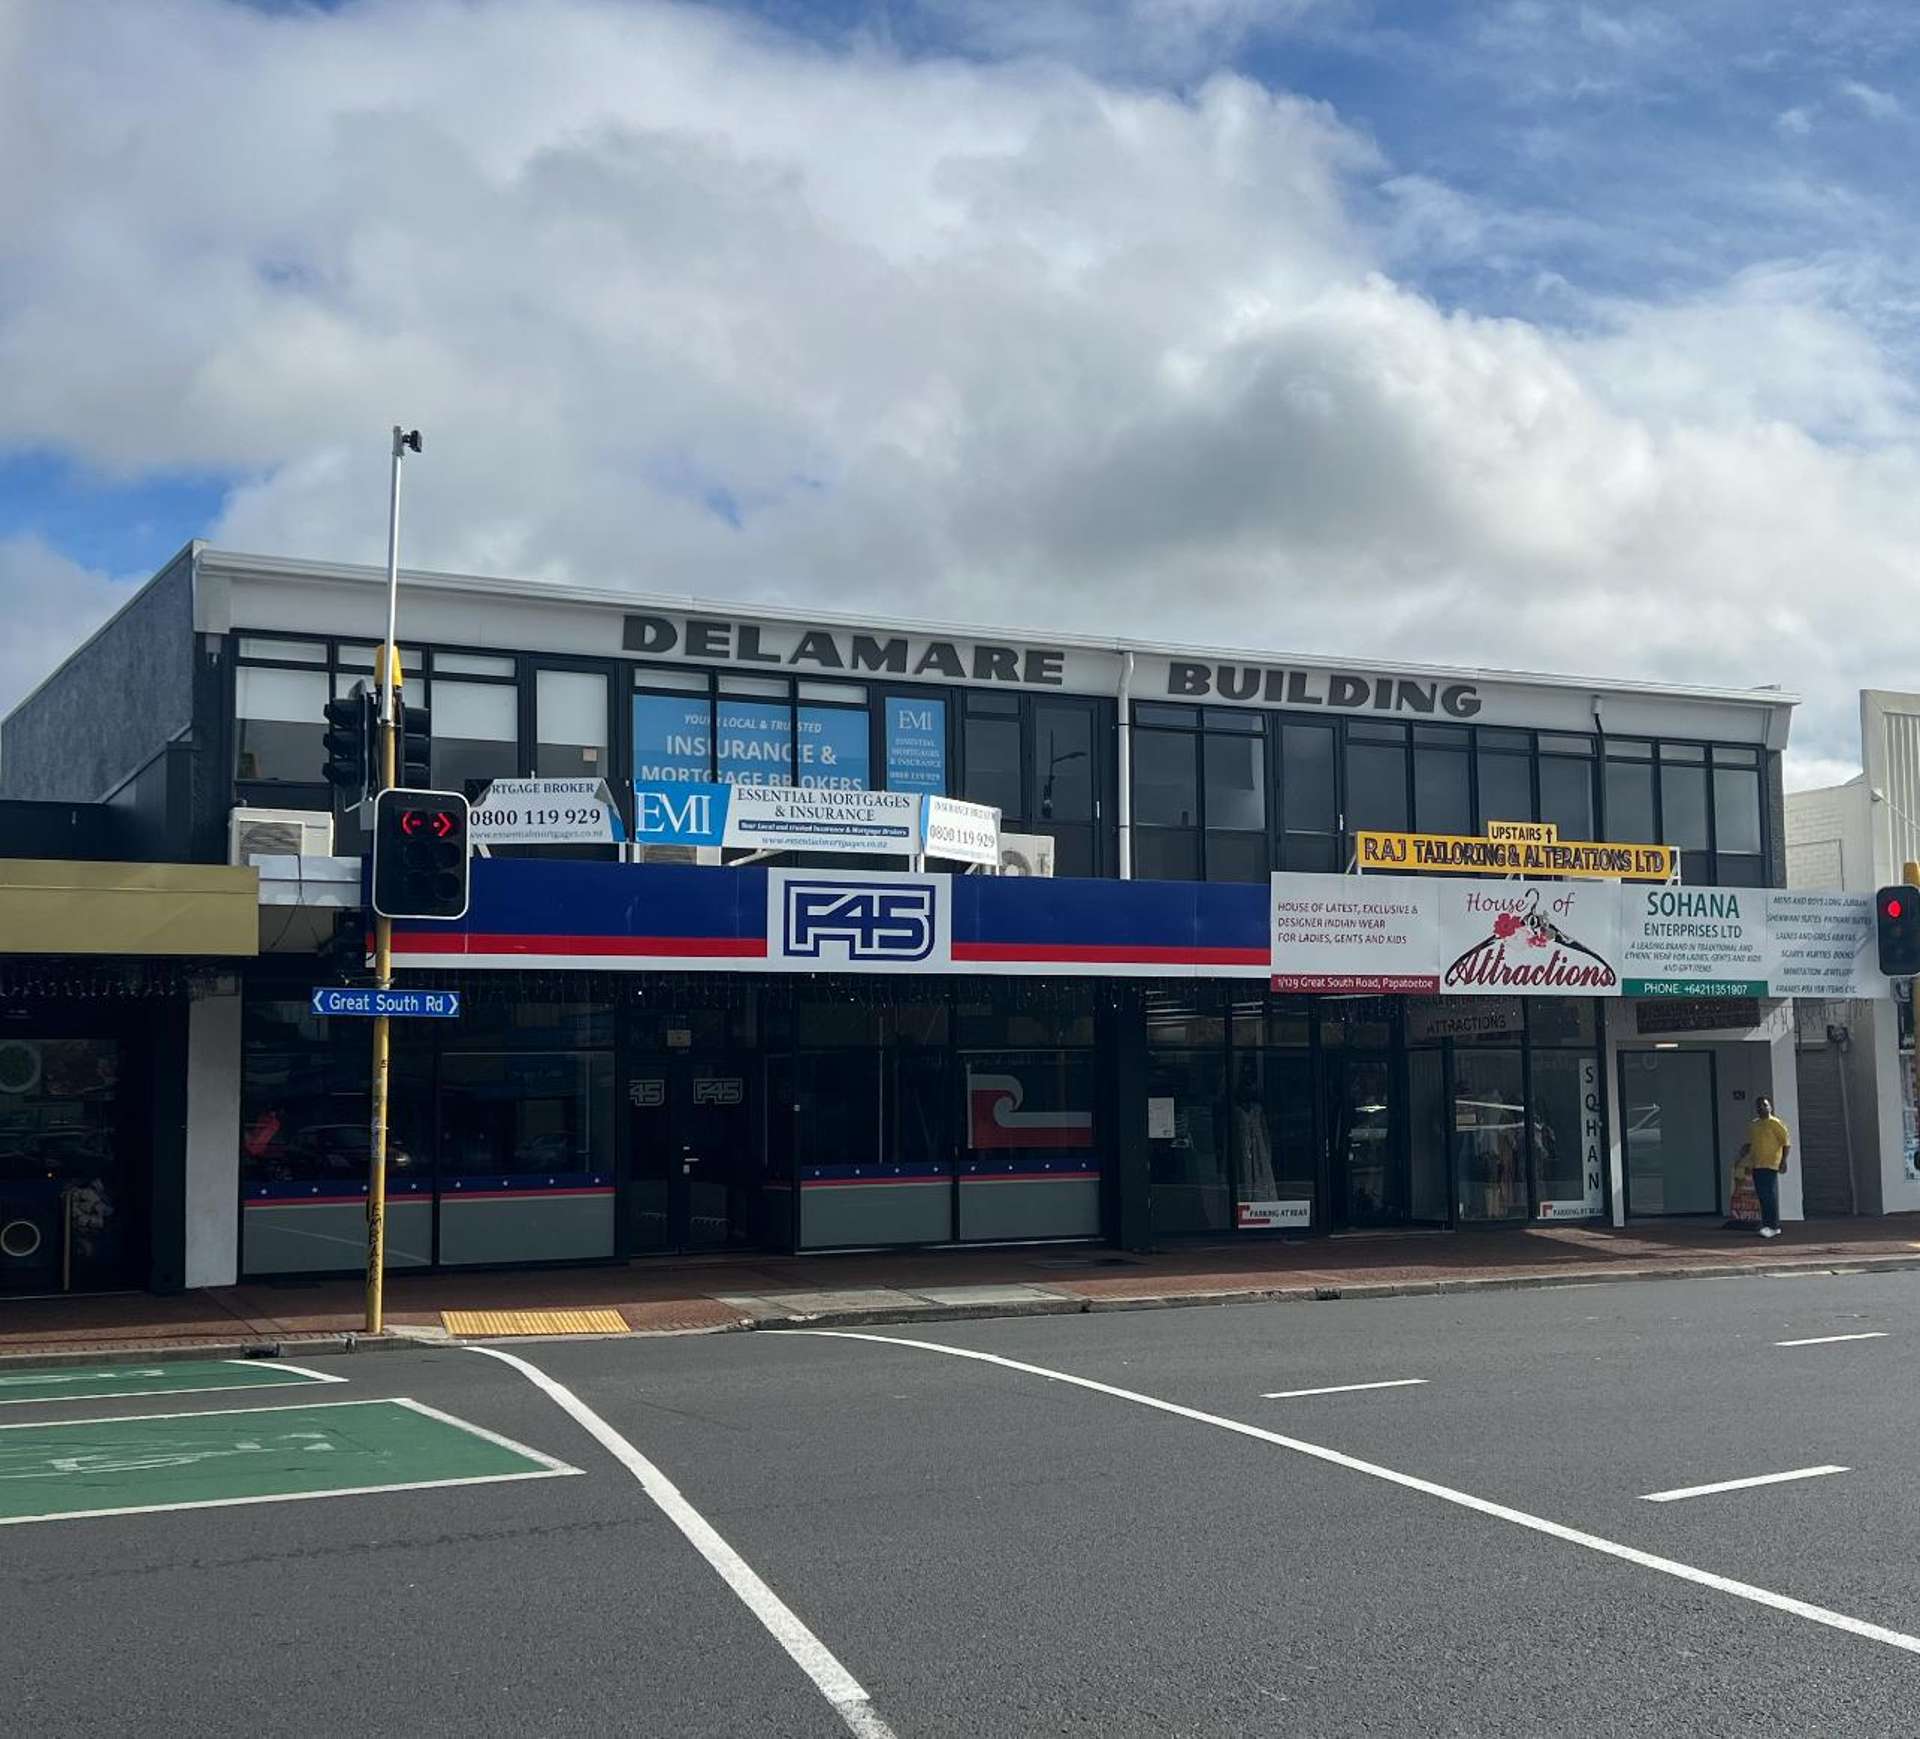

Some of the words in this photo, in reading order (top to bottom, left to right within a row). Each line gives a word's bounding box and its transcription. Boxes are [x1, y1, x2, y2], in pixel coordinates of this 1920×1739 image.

[622, 615, 1065, 685] DELAMARE
[1167, 662, 1482, 718] BUILDING
[723, 717, 756, 729] LOCAL
[897, 710, 933, 730] EMI
[666, 735, 814, 763] INSURANCE
[820, 745, 838, 765] &
[737, 788, 815, 803] ESSENTIAL
[821, 793, 910, 808] MORTGAGES
[470, 810, 517, 826] 0800
[524, 810, 559, 825] 119
[565, 809, 600, 825] 929
[636, 791, 712, 835] EMI
[775, 806, 785, 816] &
[790, 806, 875, 821] INSURANCE
[1492, 827, 1541, 840] UPSTAIRS
[1364, 838, 1406, 862] RAJ
[1414, 841, 1505, 866] TAILORING
[1508, 847, 1520, 866] &
[1523, 847, 1631, 872] ALTERATIONS
[1635, 854, 1664, 872] LTD
[1278, 902, 1309, 912] HOUSE
[1311, 903, 1323, 912] OF
[1325, 903, 1361, 914] LATEST,
[1363, 904, 1410, 914] EXCLUSIVE
[1467, 893, 1527, 913] House
[1553, 892, 1575, 917] of
[1647, 892, 1740, 918] SOHANA
[784, 880, 936, 961] F45
[1278, 918, 1323, 928] DESIGNER
[1324, 919, 1356, 928] INDIAN
[1359, 919, 1386, 928] WEAR
[1278, 933, 1296, 942] FOR
[1299, 933, 1332, 944] LADIES,
[1334, 934, 1363, 943] GENTS
[1365, 935, 1385, 944] AND
[1387, 935, 1407, 944] KIDS
[1644, 923, 1718, 938] ENTERPRISES
[1721, 925, 1742, 938] LTD
[1456, 945, 1615, 987] Attractions
[1300, 977, 1325, 987] Great
[1327, 978, 1353, 988] South
[1356, 978, 1380, 989] Road,
[1382, 979, 1433, 992] Papatoetoe
[1684, 985, 1747, 994] +64211351907
[329, 993, 370, 1010] Great
[376, 994, 418, 1012] South
[426, 996, 443, 1012] Rd
[694, 1079, 743, 1104] F45
